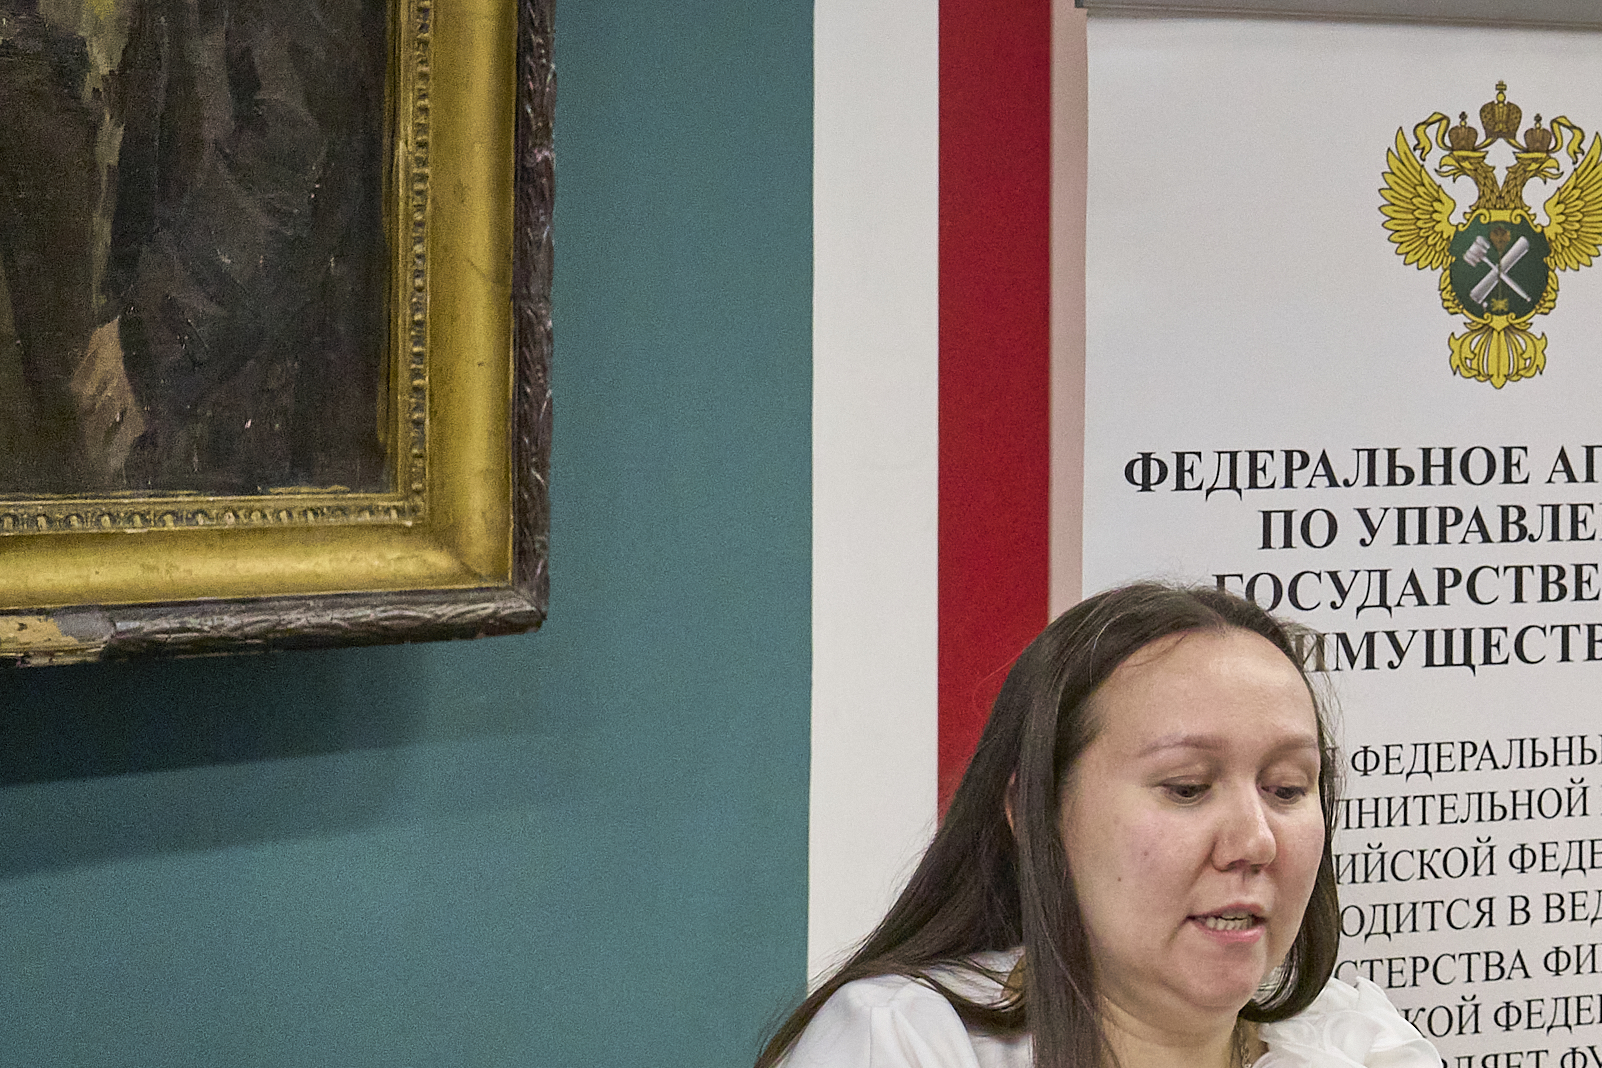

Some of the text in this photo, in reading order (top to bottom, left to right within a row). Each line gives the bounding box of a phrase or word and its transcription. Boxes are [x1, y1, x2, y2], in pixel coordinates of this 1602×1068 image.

[1123, 445, 1530, 501] ФЕДЕРАЛЬНОЕ
[1258, 508, 1339, 551] ПО
[1340, 896, 1497, 944] ОДИТСЯ
[1508, 894, 1532, 926] В
[1398, 994, 1482, 1037] КОЙ
